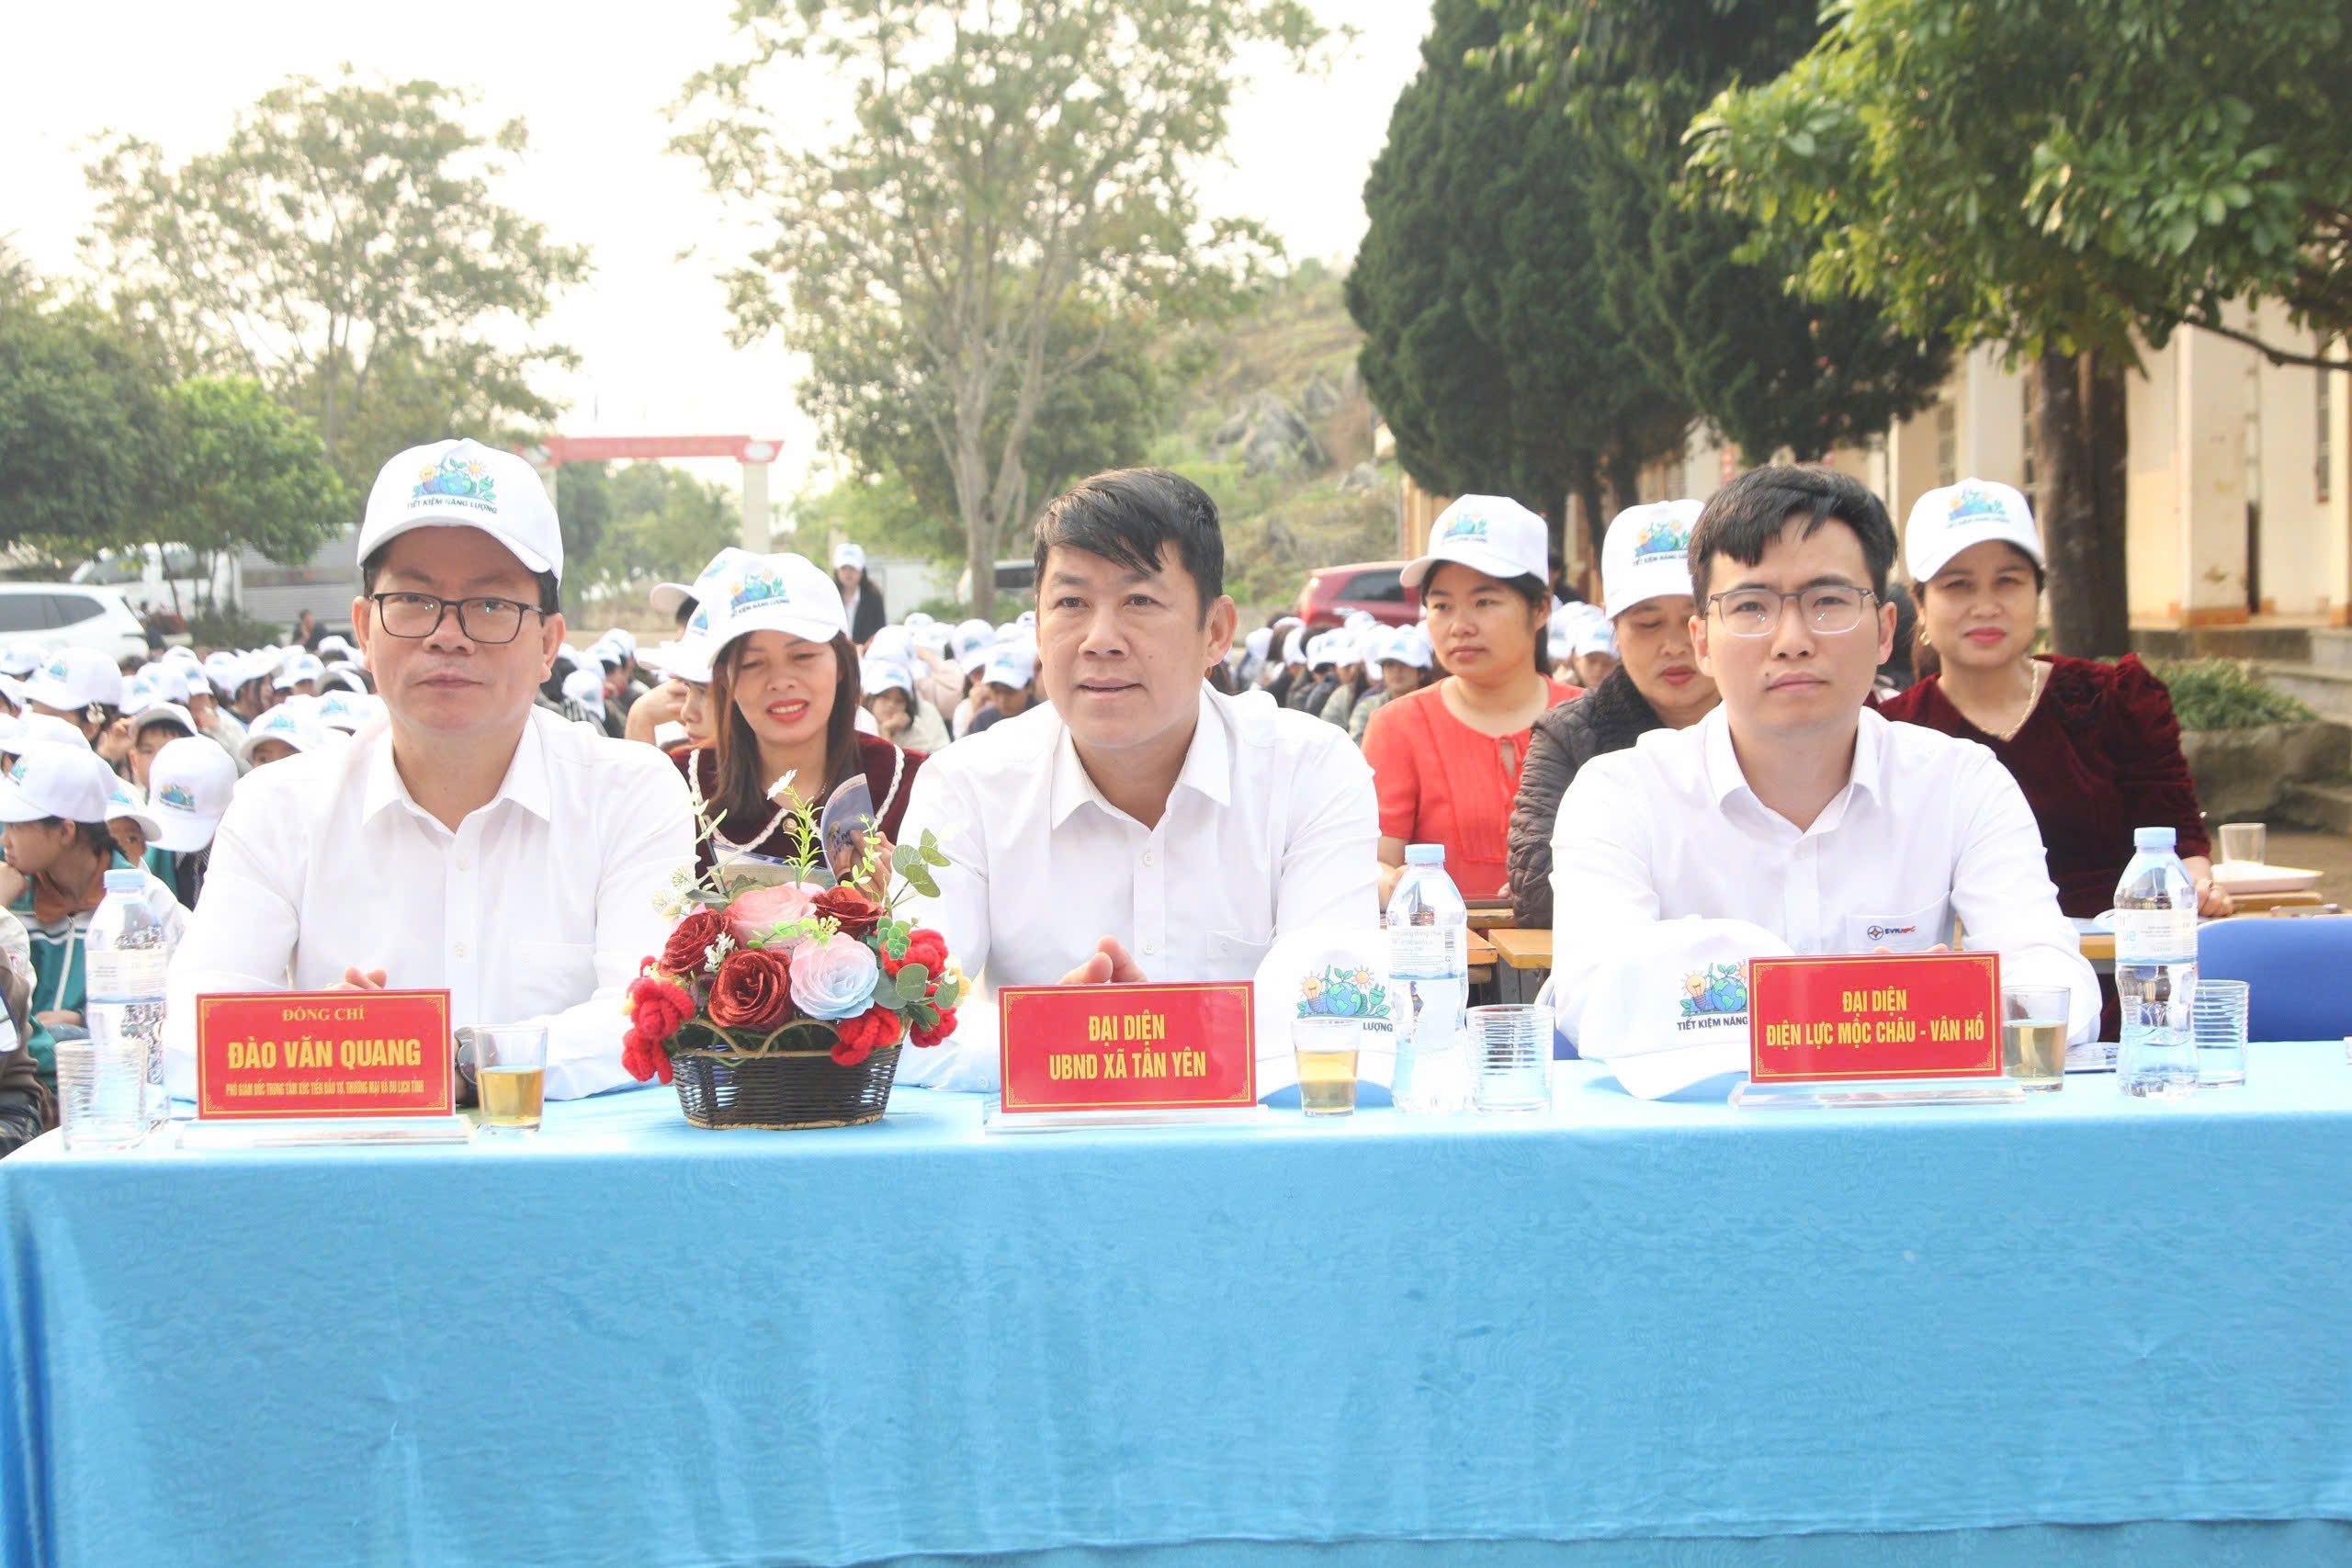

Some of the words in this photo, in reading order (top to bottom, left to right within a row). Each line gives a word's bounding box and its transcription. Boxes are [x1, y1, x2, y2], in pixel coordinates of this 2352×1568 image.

[334, 1004, 365, 1021] CHÍ
[1842, 990, 1868, 1017] ĐẠI
[1871, 986, 1907, 1016] DIỆN
[1089, 1014, 1118, 1046] ĐẠI
[1124, 1009, 1165, 1045] DIỆN
[1363, 1021, 1393, 1033] LƯỢNG
[1677, 1018, 1696, 1031] TIẾT
[1698, 1017, 1721, 1029] KIỆM
[1723, 1016, 1748, 1026] NĂNG
[1766, 1020, 1801, 1050] ĐIỆN
[1805, 1021, 1833, 1049] LỰC
[1838, 1017, 1871, 1049] MỘC
[1876, 1017, 1916, 1043] CHÂU
[1930, 1015, 1960, 1042] VÂN
[228, 1036, 277, 1068] ĐÀO
[284, 1035, 333, 1067] VĂN
[341, 1039, 421, 1070] QUANG
[1049, 1054, 1098, 1080] UBND
[1103, 1048, 1127, 1079] XÃ
[1132, 1047, 1166, 1077] TÂN
[1171, 1046, 1206, 1077] YÊN
